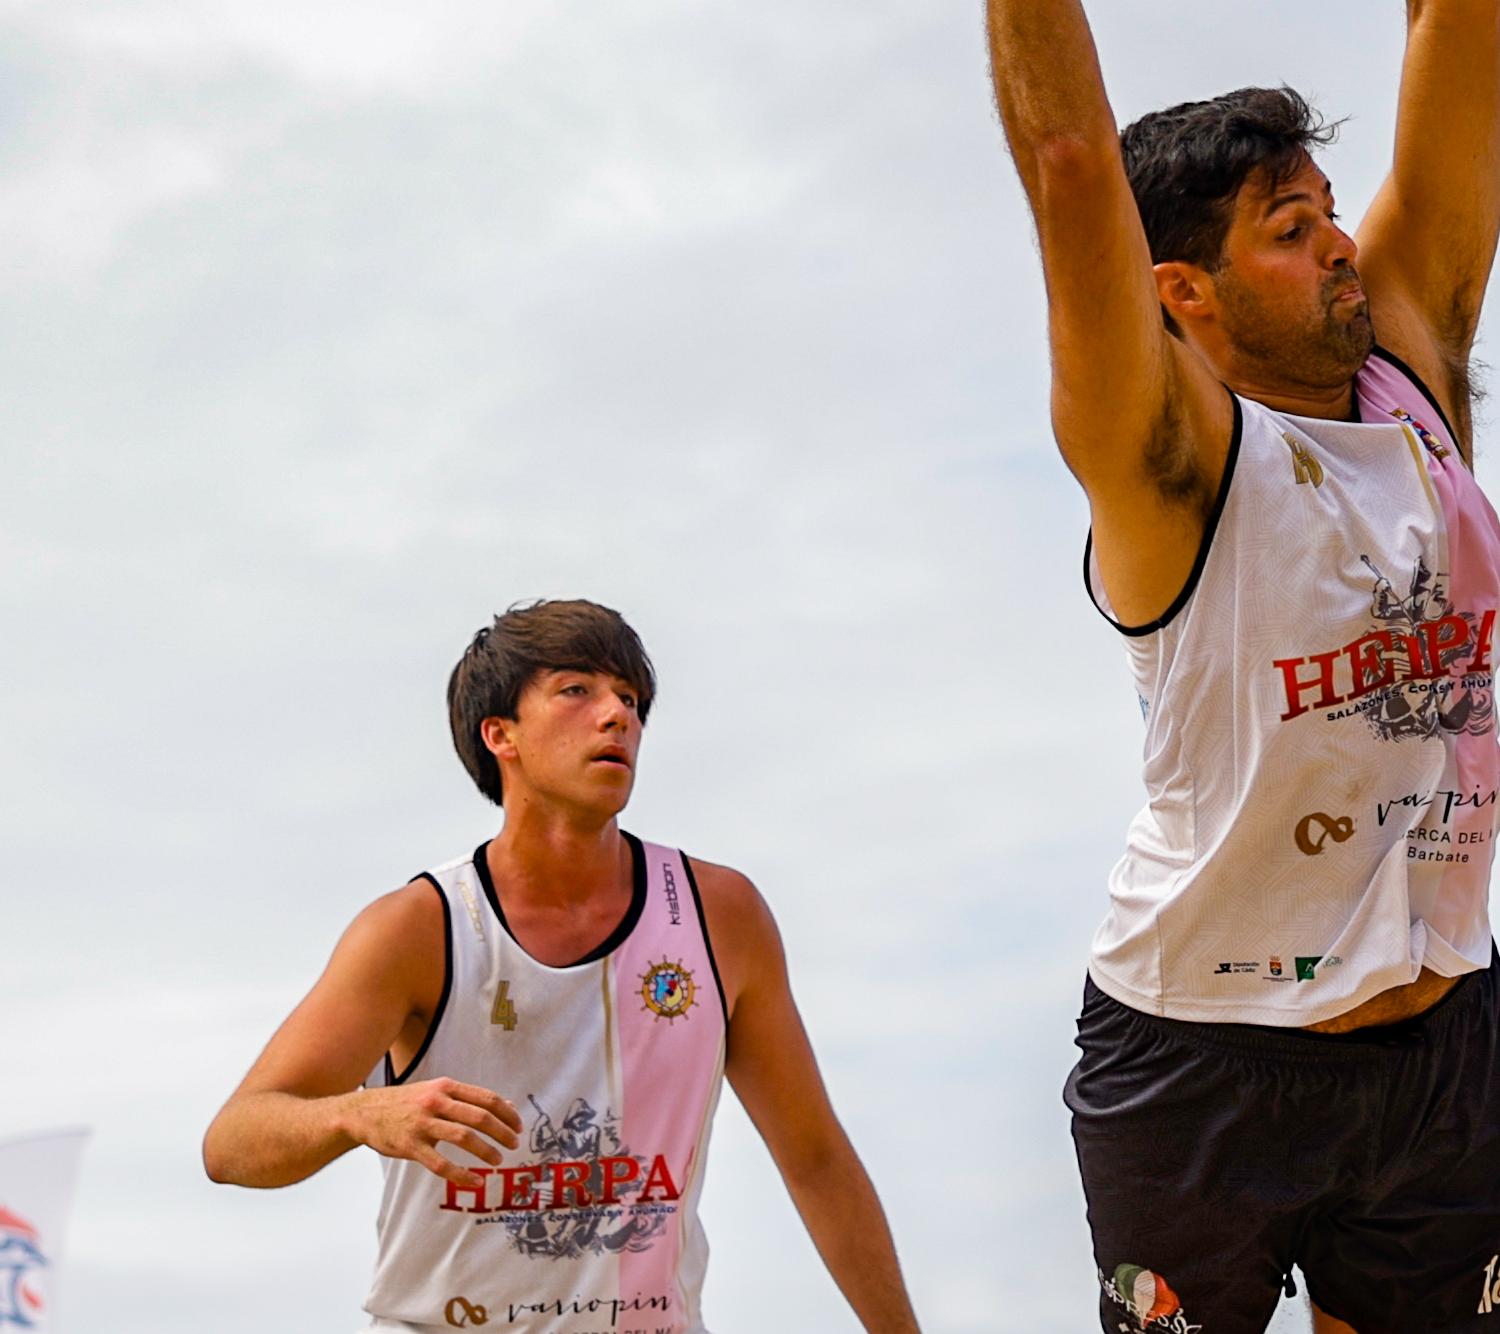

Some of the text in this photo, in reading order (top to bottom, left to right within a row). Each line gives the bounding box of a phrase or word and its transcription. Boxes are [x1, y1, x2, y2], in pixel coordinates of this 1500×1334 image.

[1402, 828, 1485, 844] ERCA DEL
[1407, 846, 1470, 863] Barbate
[490, 980, 518, 1031] 4
[439, 1144, 695, 1214] HERPA
